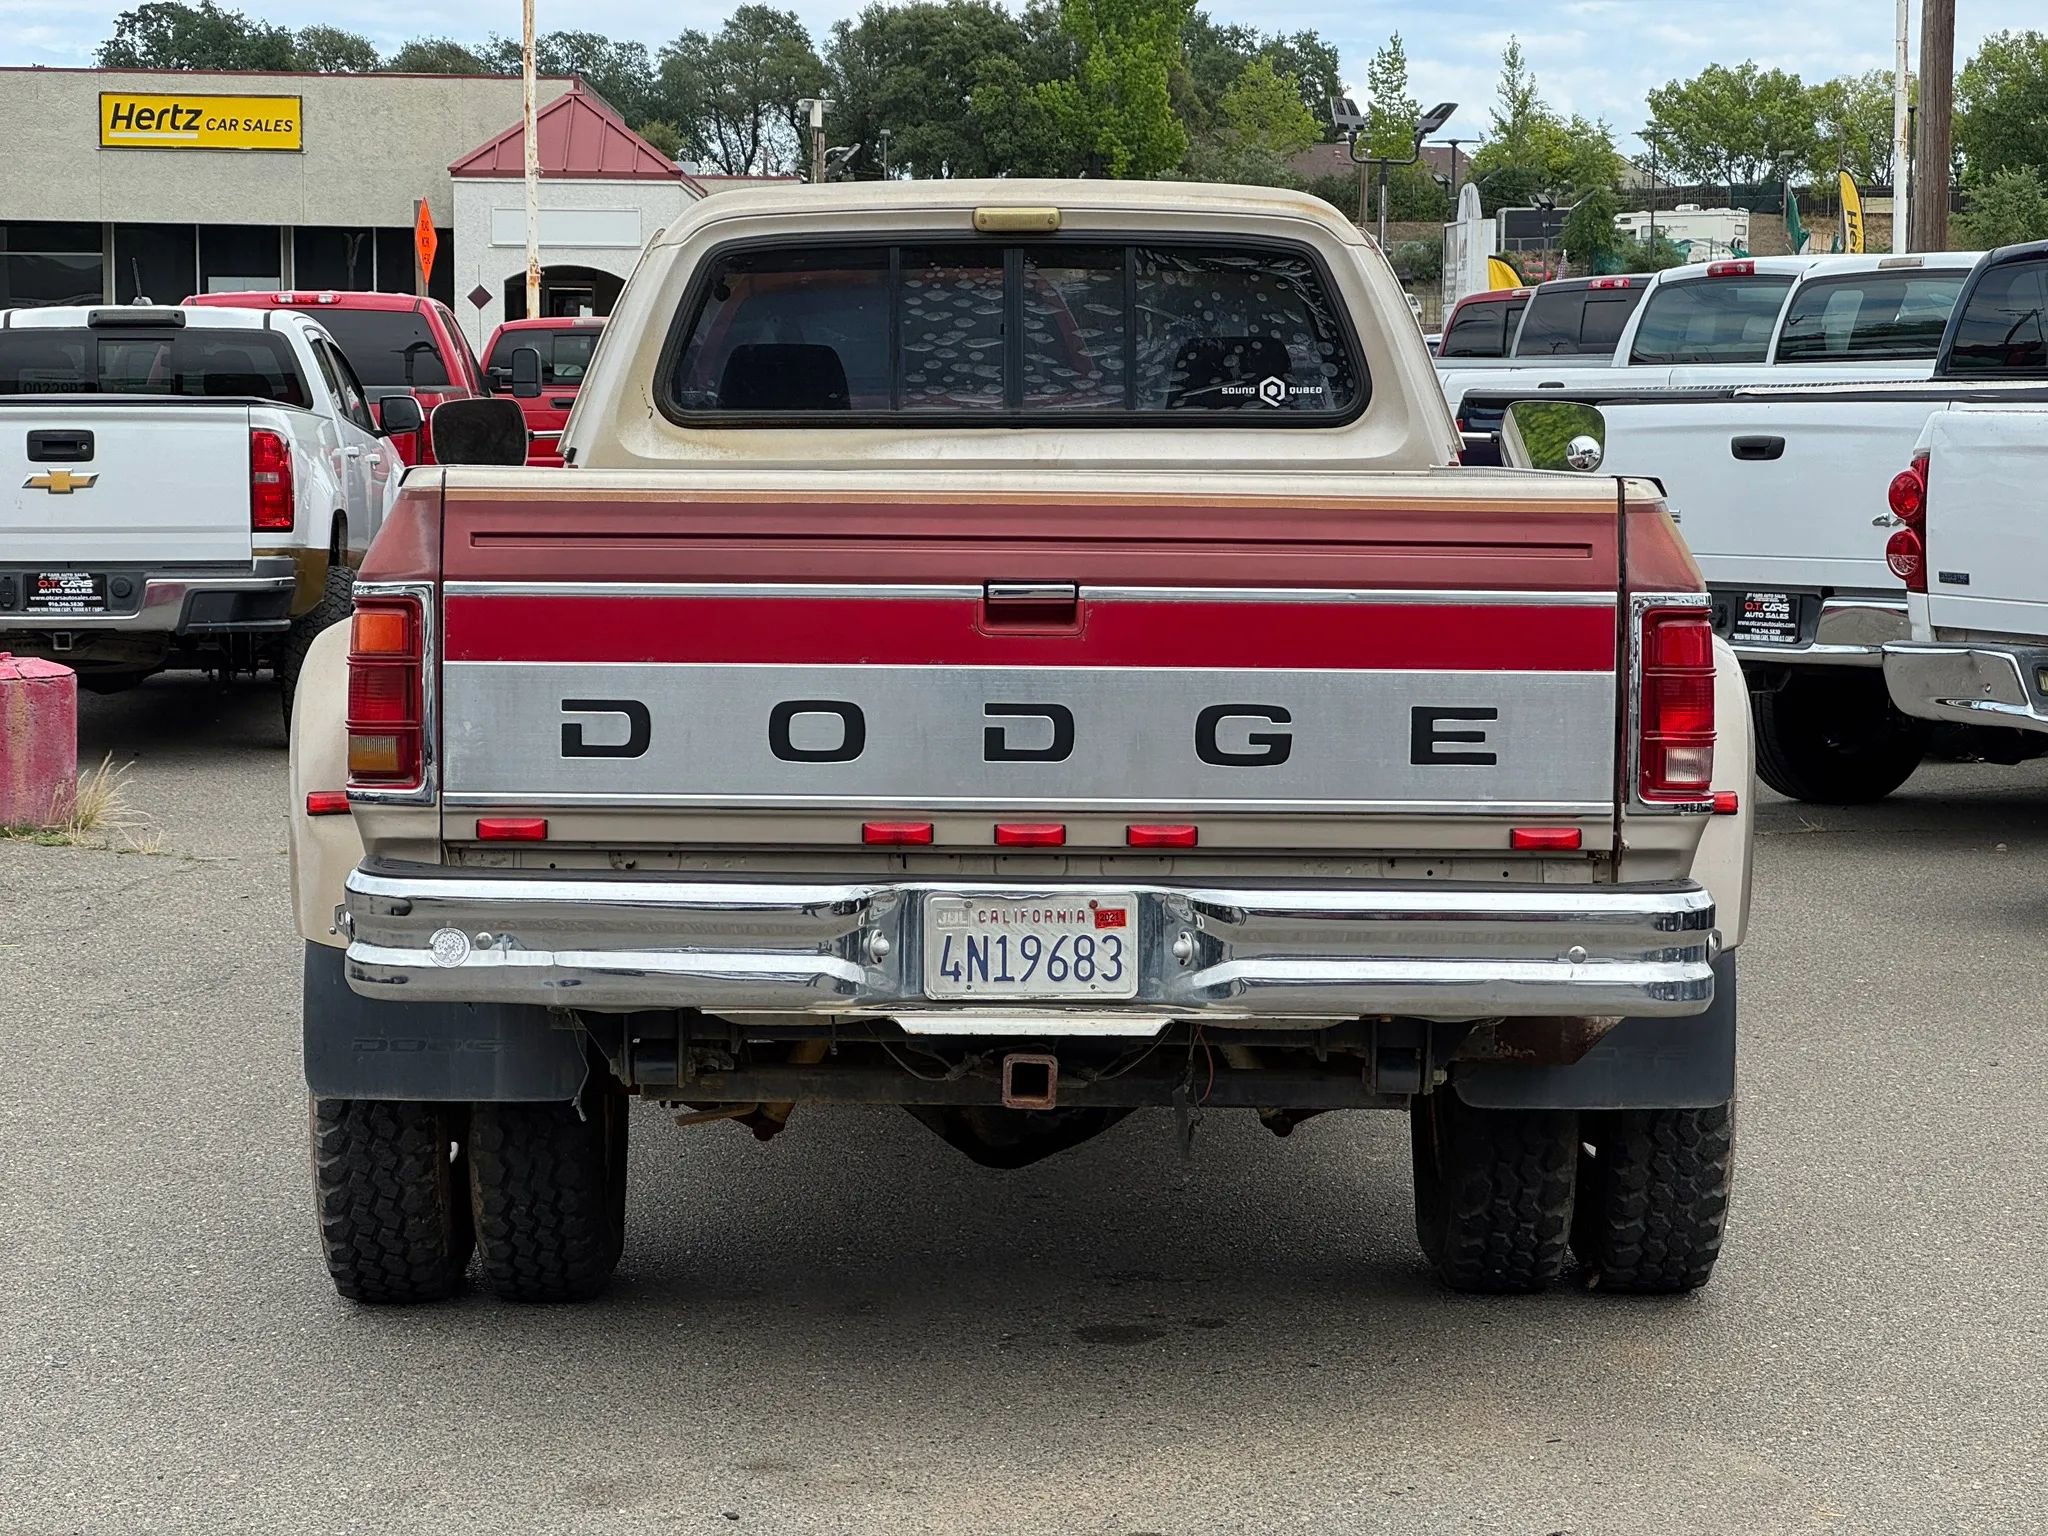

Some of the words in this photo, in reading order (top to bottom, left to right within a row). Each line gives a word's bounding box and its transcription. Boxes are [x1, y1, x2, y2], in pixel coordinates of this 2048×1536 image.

[110, 103, 203, 130] Hertz
[206, 118, 238, 132] CAR
[242, 118, 294, 133] SALES
[1765, 612, 1789, 620] SALES
[561, 699, 1498, 766] DODGE
[937, 909, 968, 925] JUL
[978, 909, 1086, 924] CALIFORNIA
[1099, 912, 1120, 922] 2021
[940, 934, 1123, 983] 4N19683
